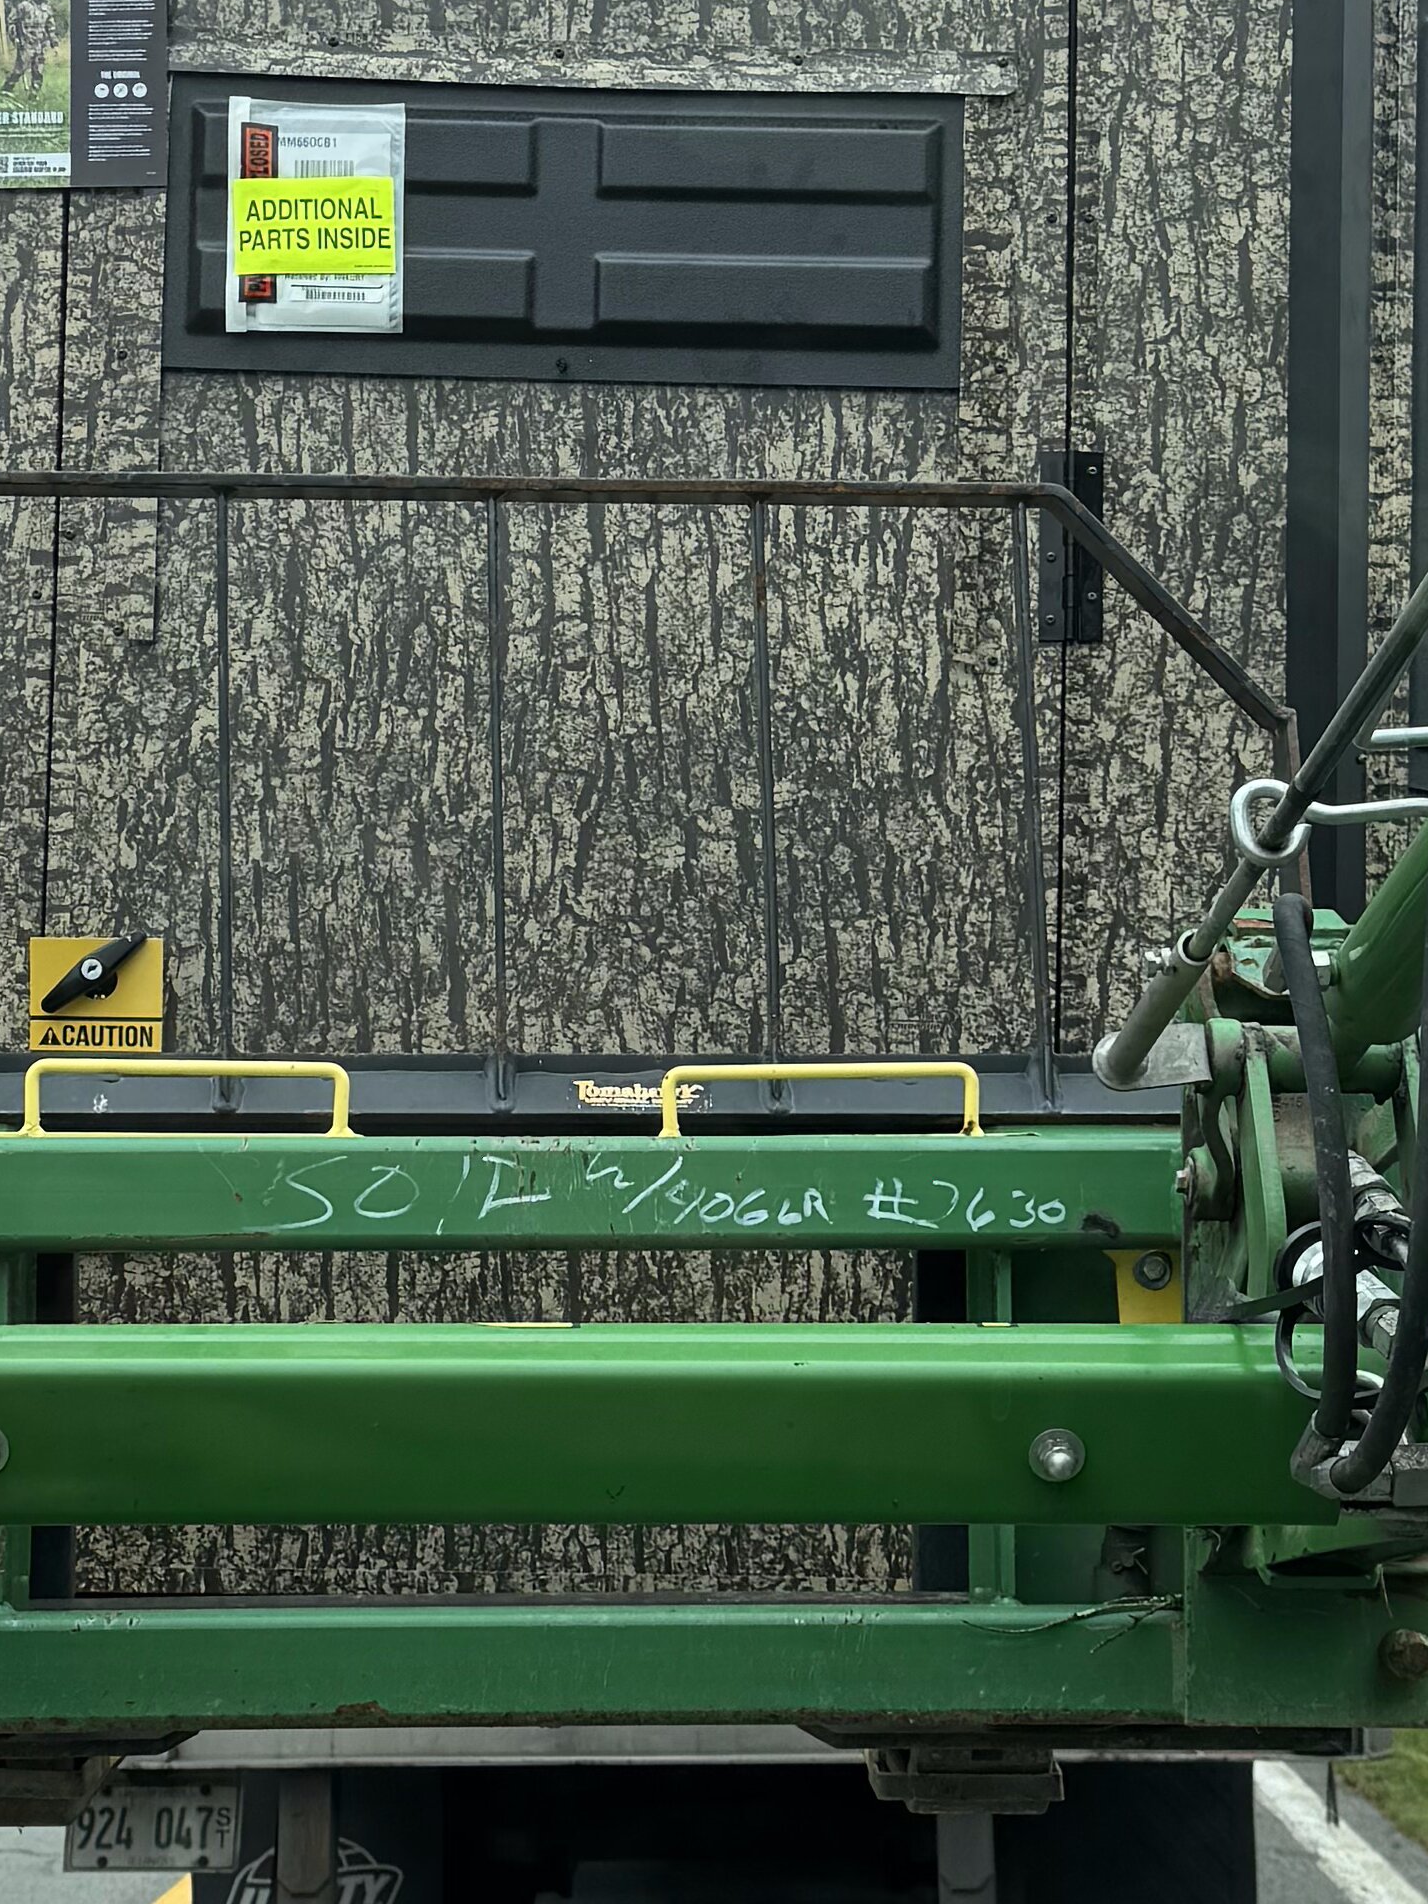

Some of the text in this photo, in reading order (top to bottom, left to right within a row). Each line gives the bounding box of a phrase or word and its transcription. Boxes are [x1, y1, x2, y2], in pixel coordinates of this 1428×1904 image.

[246, 197, 383, 222] ADDITIONAL
[239, 227, 392, 251] PARTS INSIDE
[62, 1024, 153, 1047] CAUTION
[77, 1806, 133, 1850] 924
[153, 1806, 214, 1850] 047
